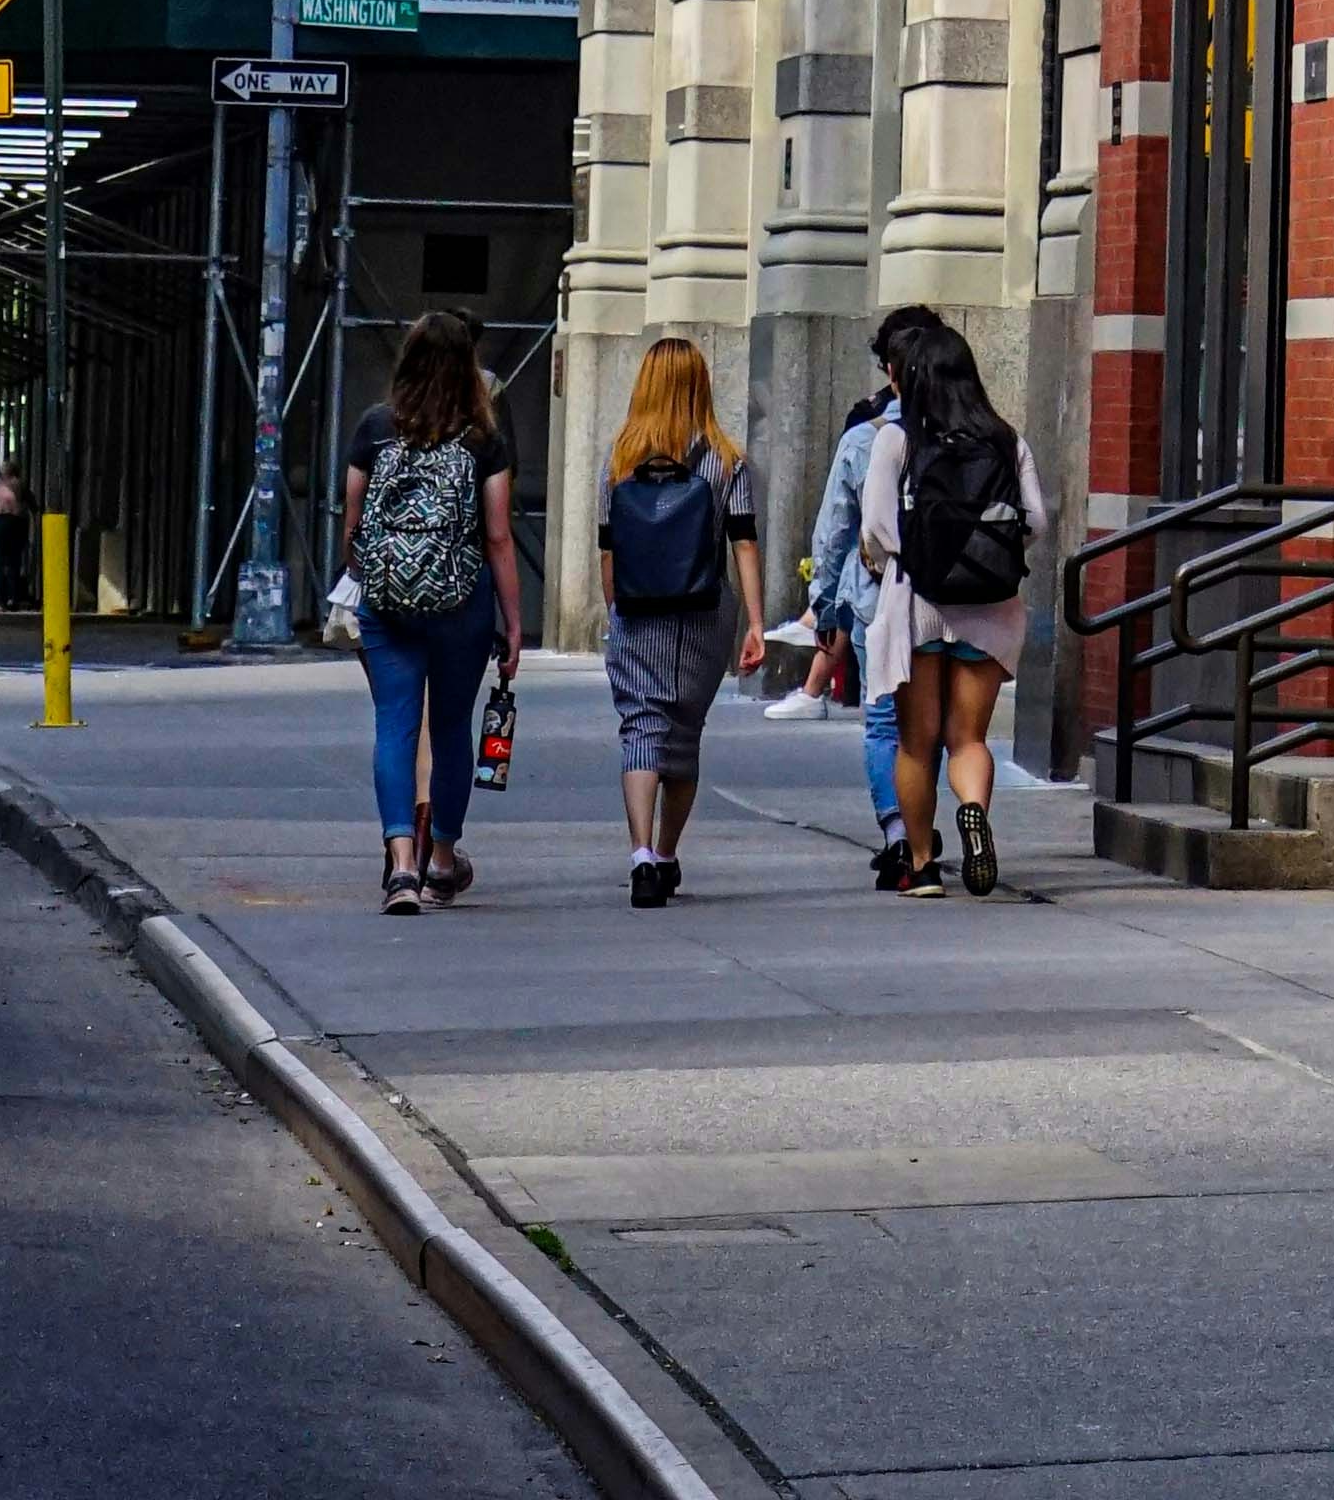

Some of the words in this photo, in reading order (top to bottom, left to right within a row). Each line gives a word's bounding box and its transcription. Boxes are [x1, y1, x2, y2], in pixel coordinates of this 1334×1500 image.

[400, 2, 415, 16] PL
[234, 73, 271, 91] ONE
[289, 75, 329, 93] WAY
